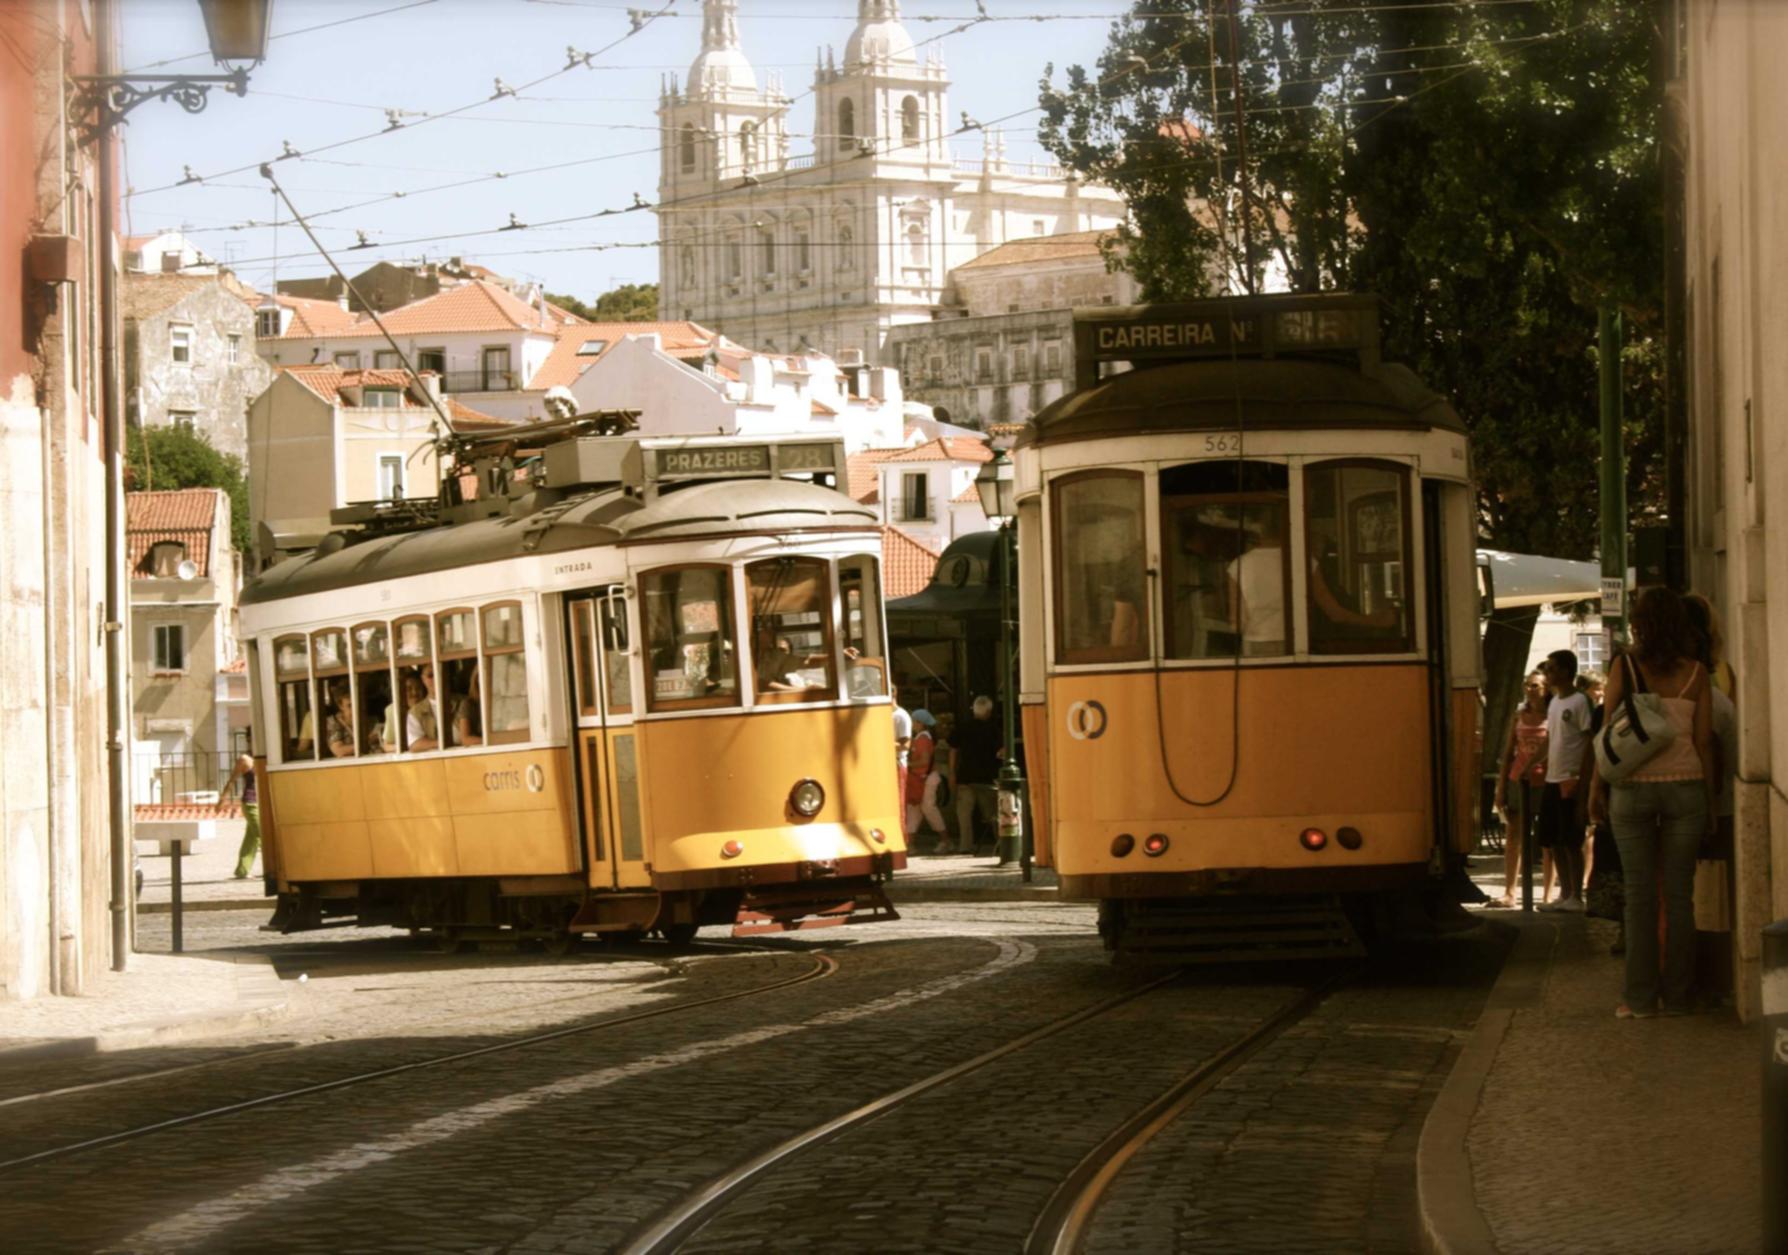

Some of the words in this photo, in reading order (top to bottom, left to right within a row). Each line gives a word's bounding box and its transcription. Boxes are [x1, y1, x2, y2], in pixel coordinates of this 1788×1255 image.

[1099, 322, 1216, 349] CARREIRA
[1205, 434, 1240, 452] 562
[666, 449, 761, 472] PRAZERES
[788, 448, 822, 468] 28
[554, 561, 592, 575] ENTRADA
[483, 762, 520, 791] carris
